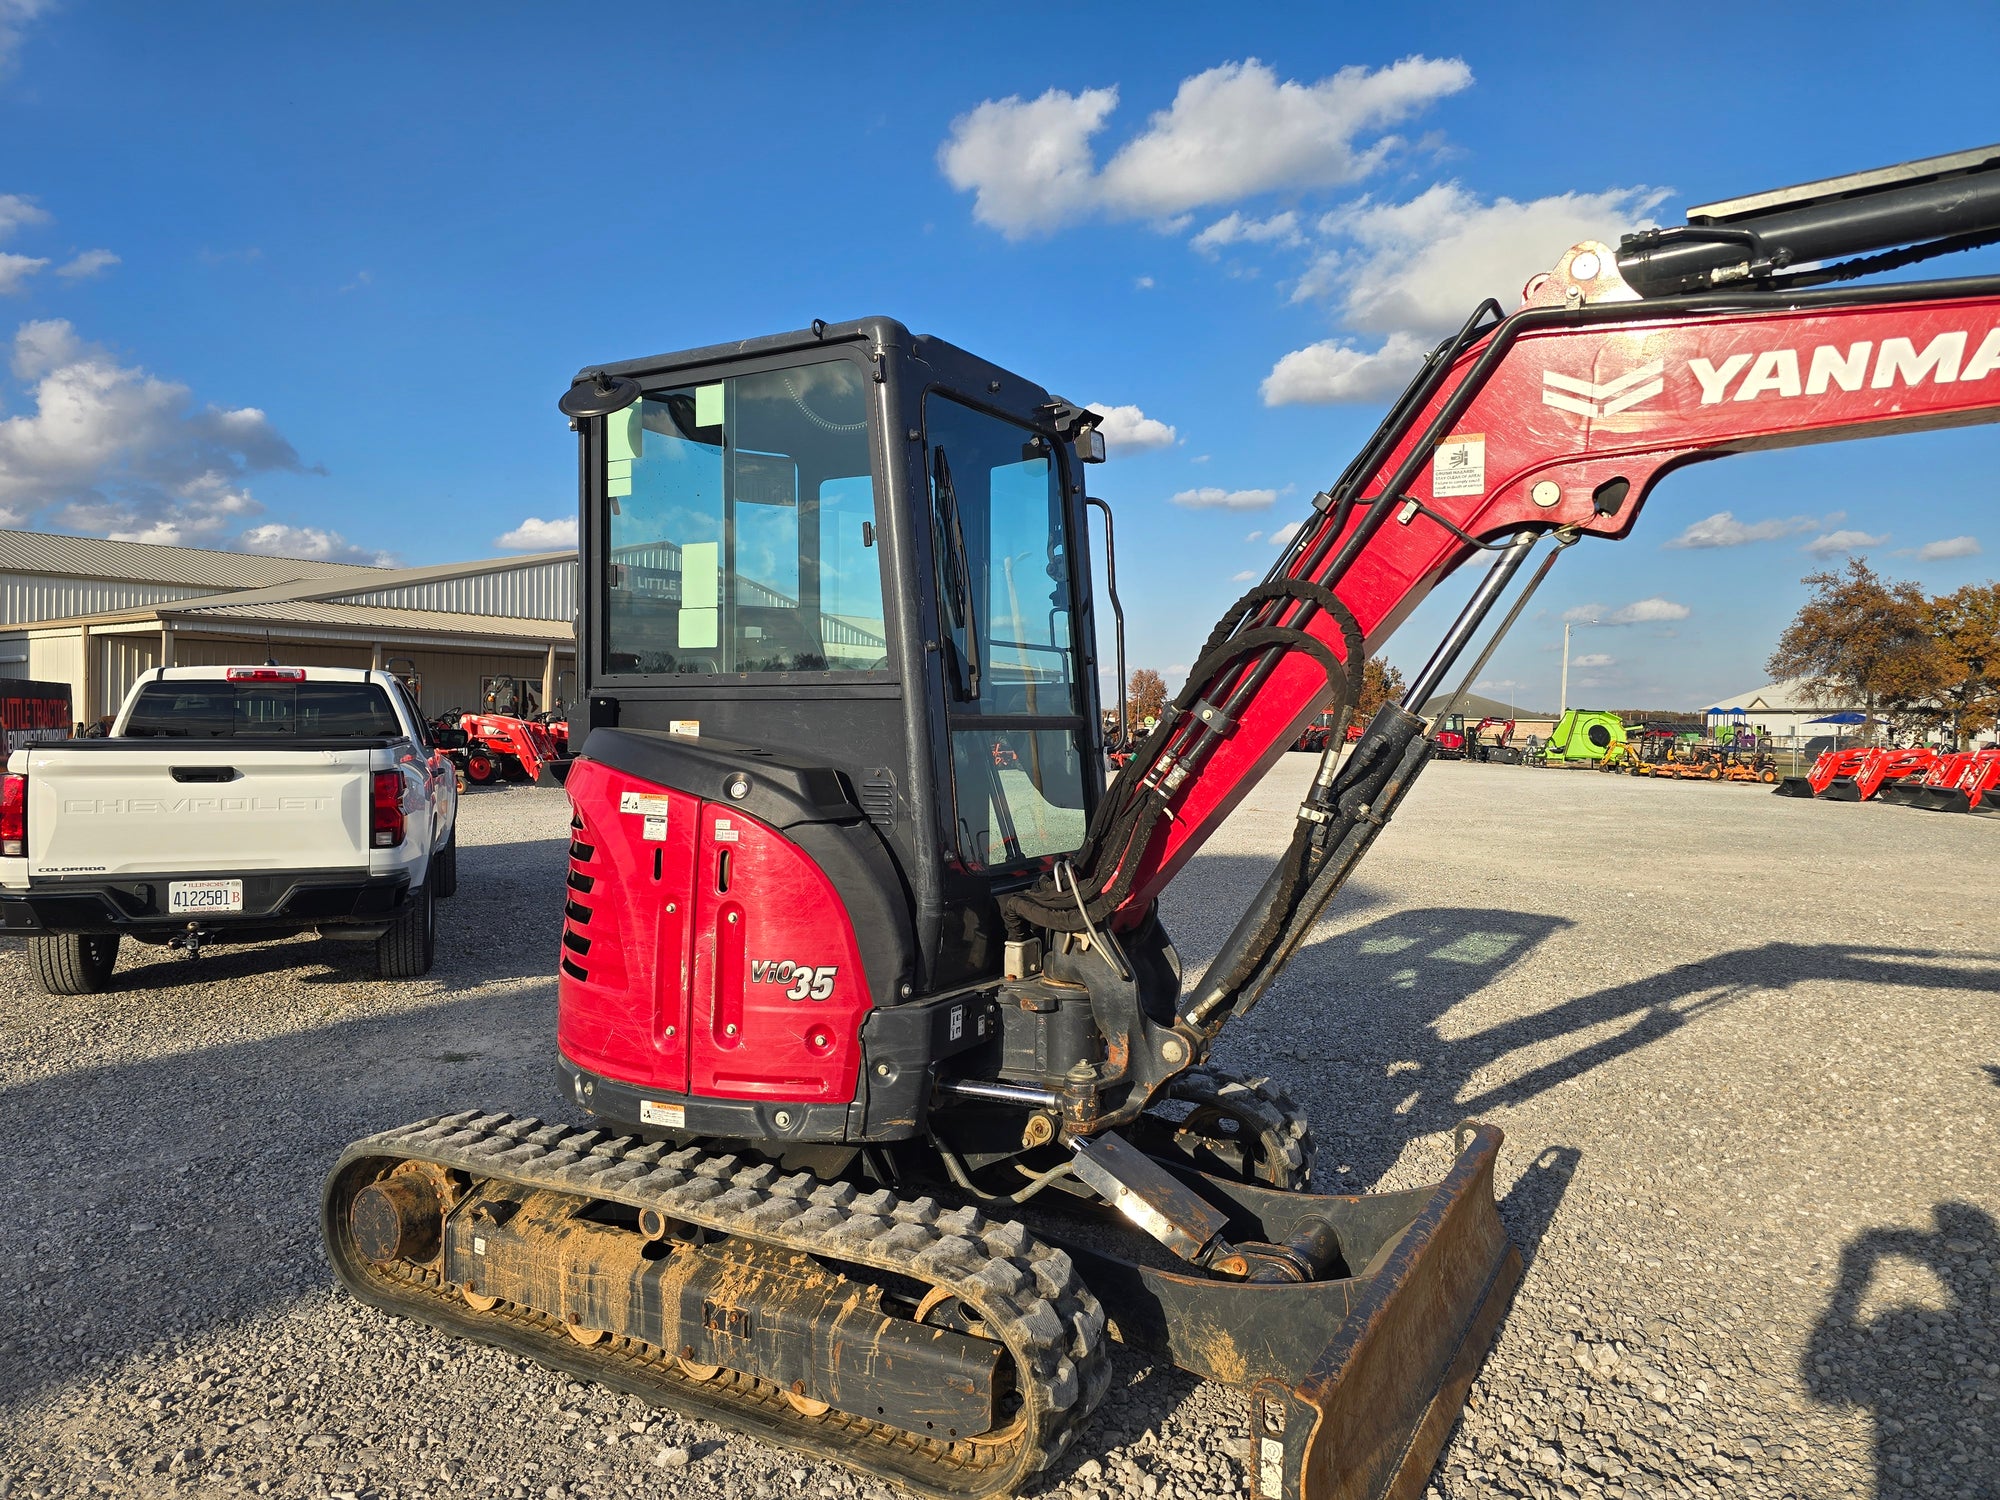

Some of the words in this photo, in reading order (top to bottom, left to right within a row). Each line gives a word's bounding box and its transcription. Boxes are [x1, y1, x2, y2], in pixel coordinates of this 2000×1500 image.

[637, 576, 677, 591] LITTLE
[1, 698, 30, 730] LITTLE
[64, 796, 335, 815] CHEVROLET
[38, 865, 106, 873] COLORADO
[173, 890, 230, 907] 4122581
[232, 891, 241, 903] B
